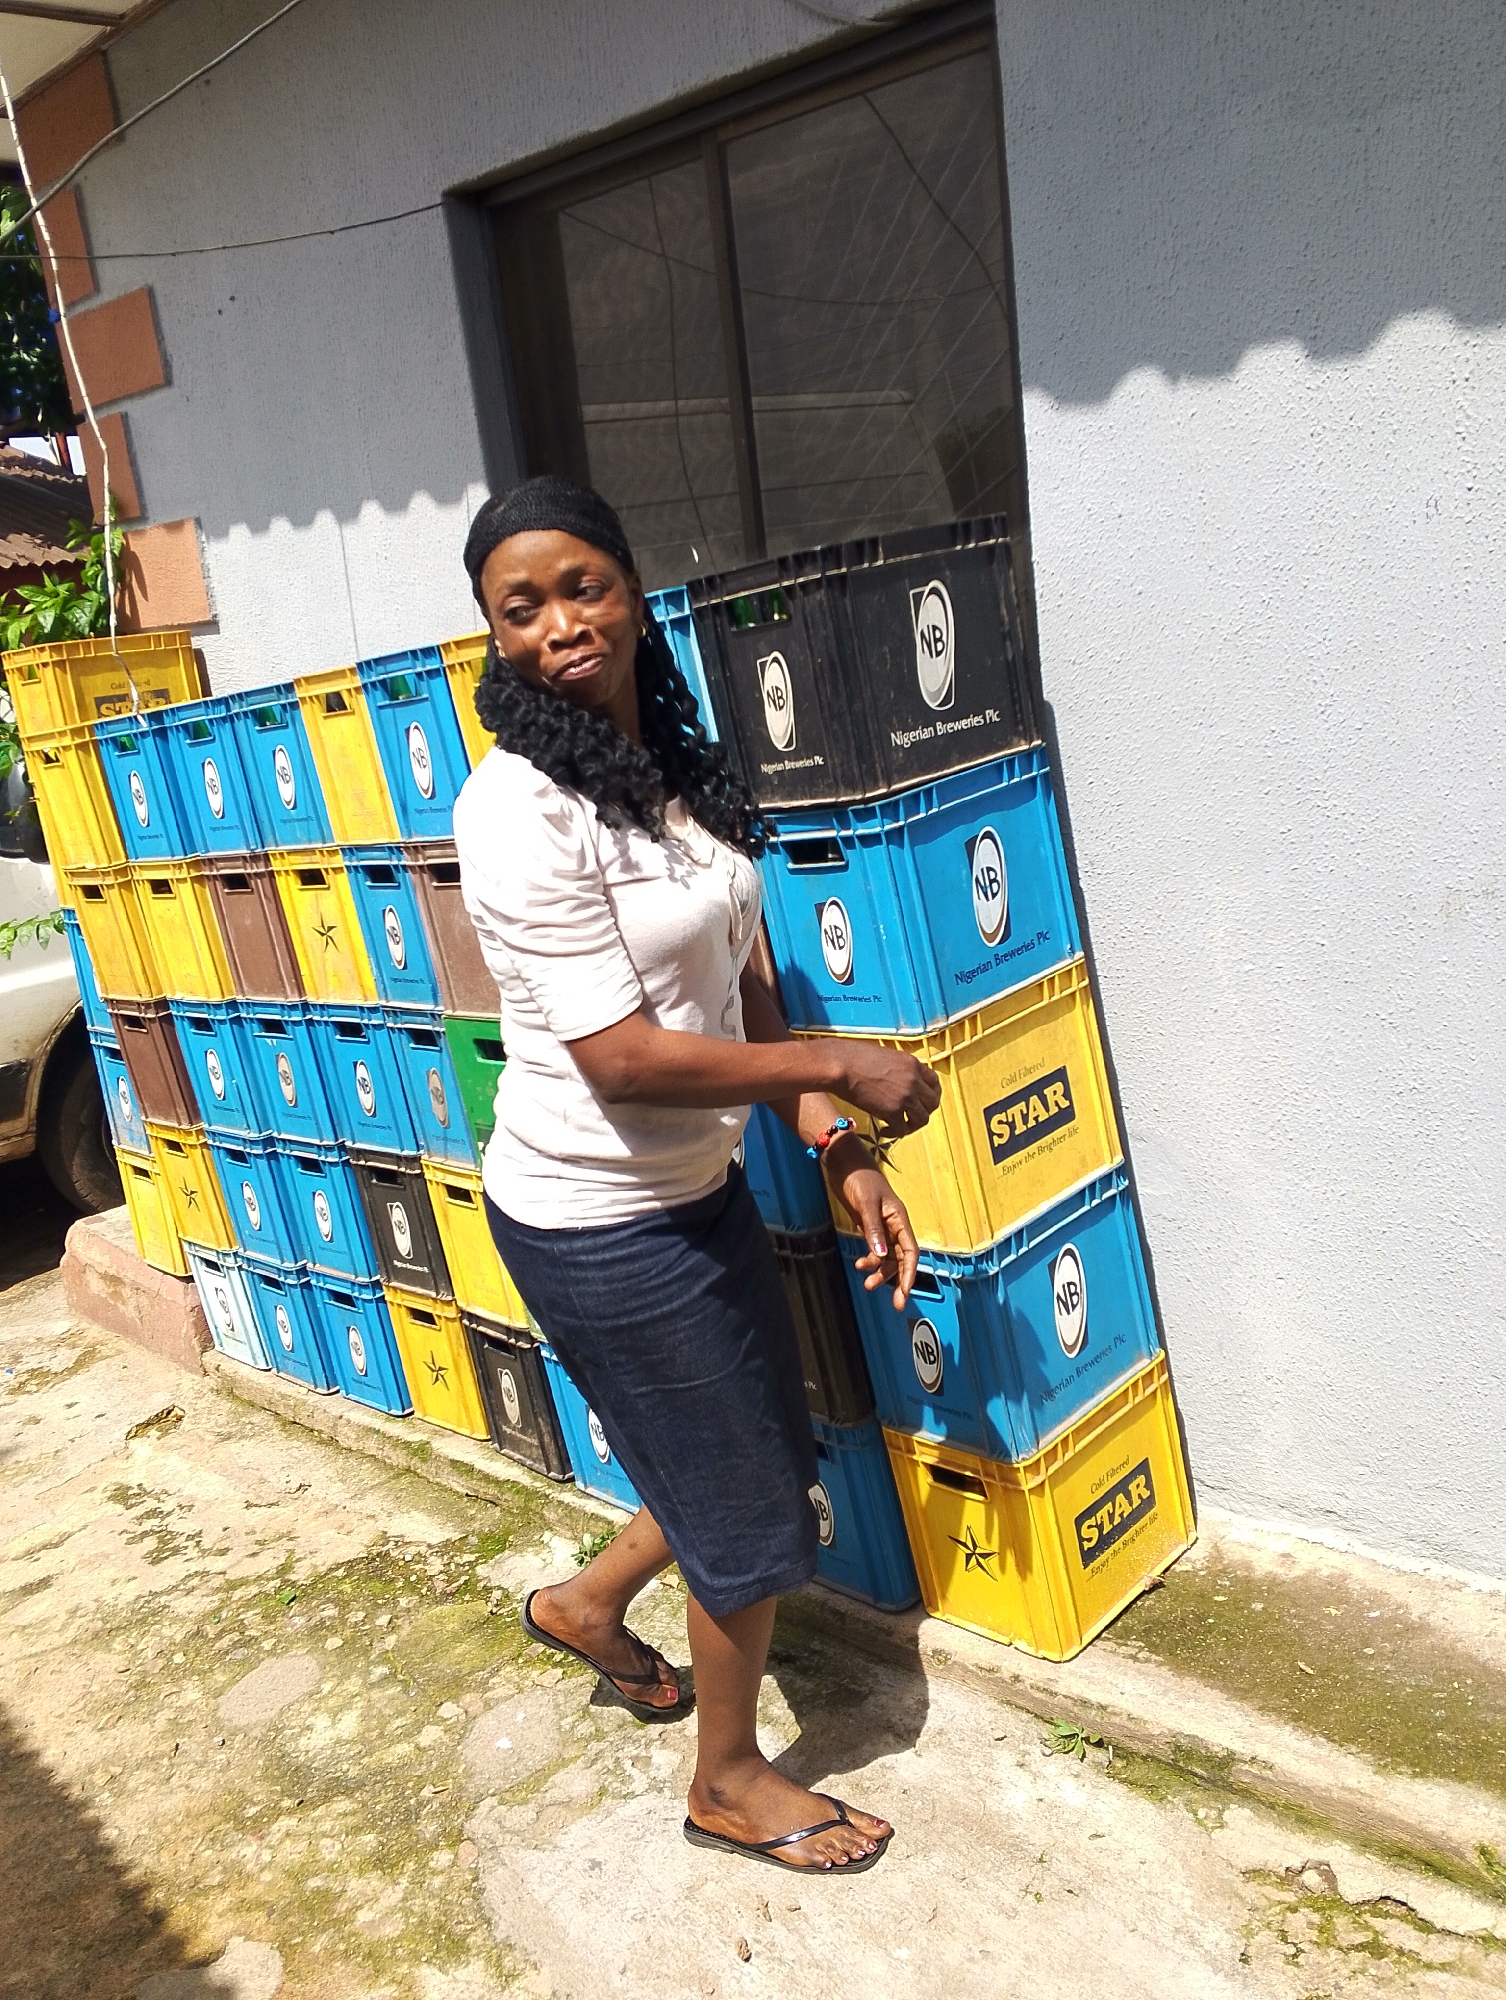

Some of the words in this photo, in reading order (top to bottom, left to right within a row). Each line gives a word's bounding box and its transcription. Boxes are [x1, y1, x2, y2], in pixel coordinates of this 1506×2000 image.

[920, 624, 945, 659] NB
[767, 685, 785, 712] NB
[890, 725, 935, 748] Nigerian
[935, 714, 984, 736] Breweries
[985, 709, 1001, 724] Plc
[412, 747, 428, 769] NB
[760, 762, 784, 775] Nigerian
[784, 758, 814, 770] Breweries
[814, 755, 825, 766] Plc
[277, 766, 291, 785] NB
[975, 866, 1001, 902] NB
[387, 926, 401, 945] NB
[824, 925, 846, 950] NB
[954, 960, 993, 985] Nigerian
[993, 939, 1035, 967] Breweries
[1036, 930, 1050, 945] Plc
[817, 993, 842, 1003] Nigerian
[842, 993, 872, 1003] Breweries
[873, 995, 882, 1003] Plc
[358, 1076, 371, 1094] NB
[1000, 1069, 1017, 1089] Cold
[1018, 1057, 1046, 1080] Filtered
[990, 1081, 1070, 1148] STAR
[1024, 1151, 1037, 1163] the
[1037, 1134, 1067, 1156] Brighter
[1068, 1125, 1079, 1138] life
[394, 1220, 406, 1235] NB
[1056, 1281, 1080, 1316] NB
[914, 1340, 937, 1366] NB
[1040, 1374, 1075, 1406] Nigerian
[1075, 1344, 1113, 1379] Breweries
[1113, 1333, 1127, 1349] Plc
[503, 1387, 515, 1403] NB
[1090, 1476, 1106, 1495] Cold
[1106, 1455, 1130, 1481] Filtered
[1081, 1475, 1151, 1551] STAR
[1110, 1547, 1121, 1560] the
[1121, 1521, 1148, 1551] Brighter
